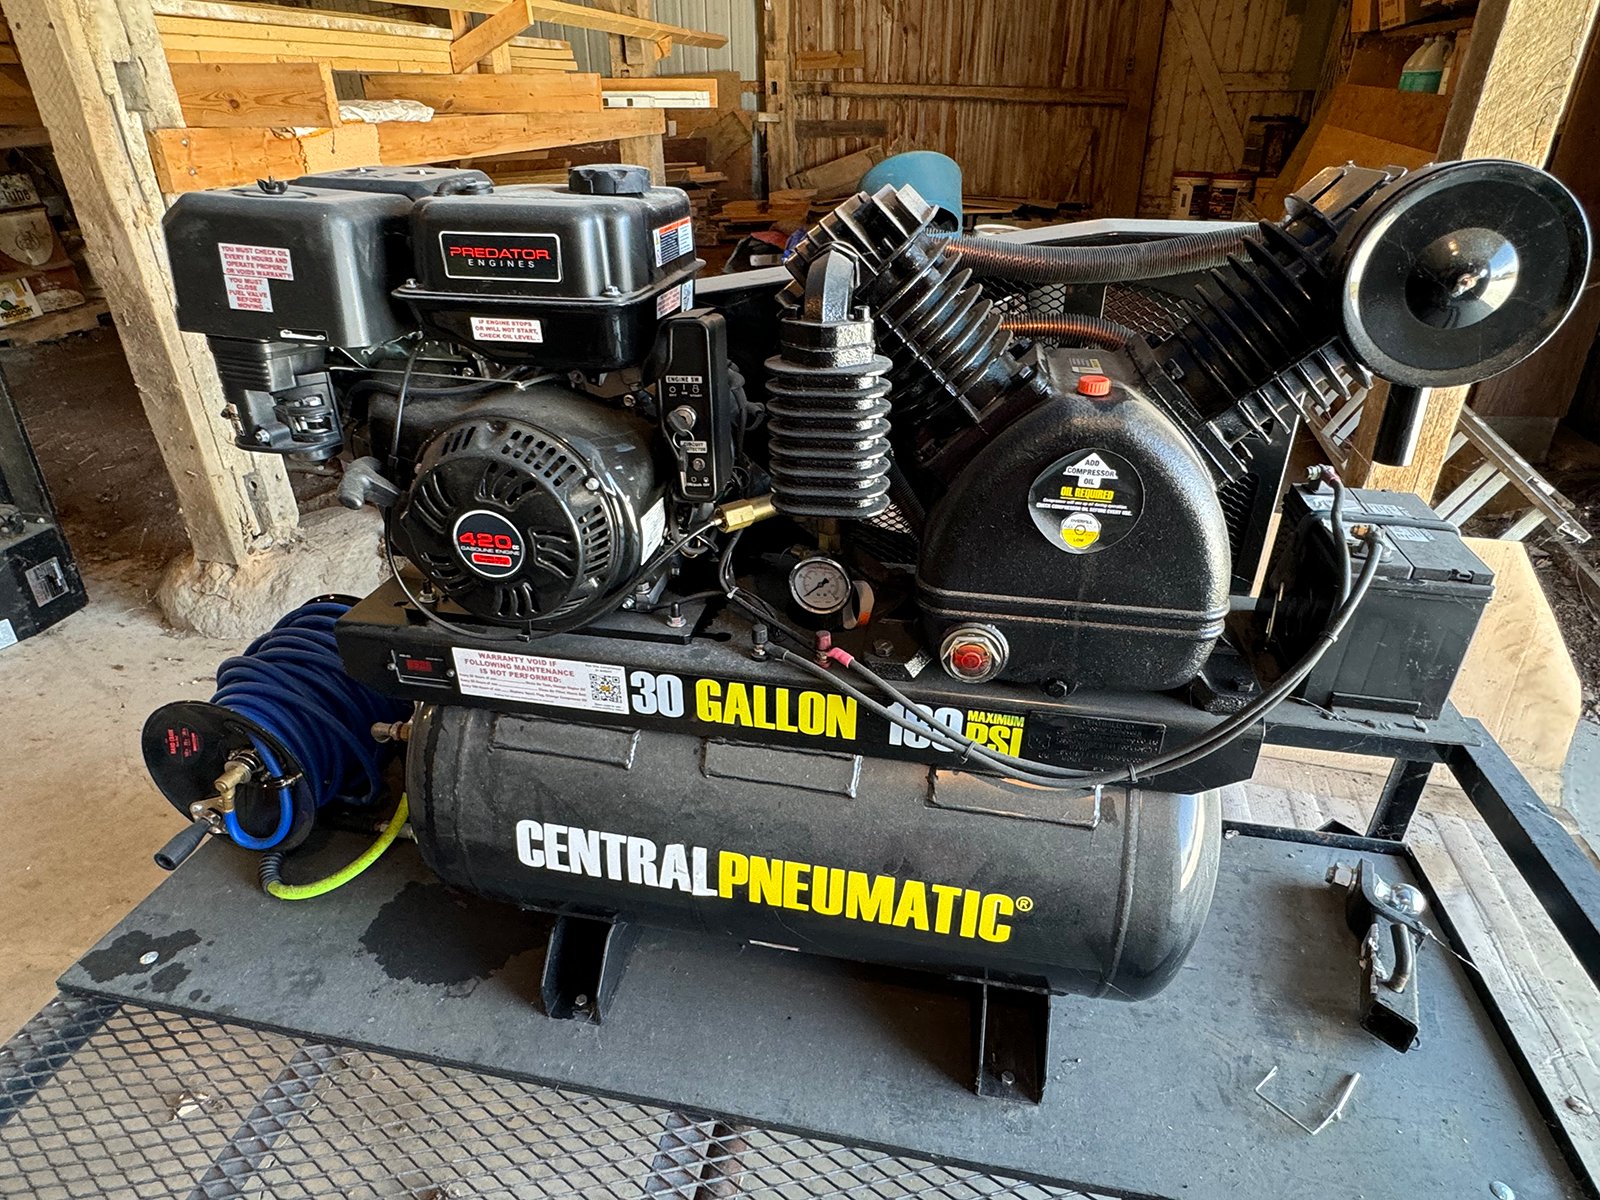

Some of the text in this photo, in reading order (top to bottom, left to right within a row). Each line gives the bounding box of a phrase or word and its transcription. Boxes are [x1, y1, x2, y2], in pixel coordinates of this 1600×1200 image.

[450, 246, 551, 260] PREDATOR
[468, 259, 535, 268] ENGINES
[1067, 468, 1115, 477] COMPRESSOR
[1061, 486, 1114, 500] OIL REQUIRED
[478, 652, 525, 664] WARRANTY
[526, 657, 547, 666] VOID
[464, 658, 512, 671] FOLLOWING
[514, 664, 575, 677] MAINTENANCE
[509, 671, 562, 683] PERFORMED:
[630, 670, 684, 719] 30
[695, 678, 857, 741] GALLON
[965, 721, 1024, 759] PSI
[967, 709, 1024, 727] MAXIMUM
